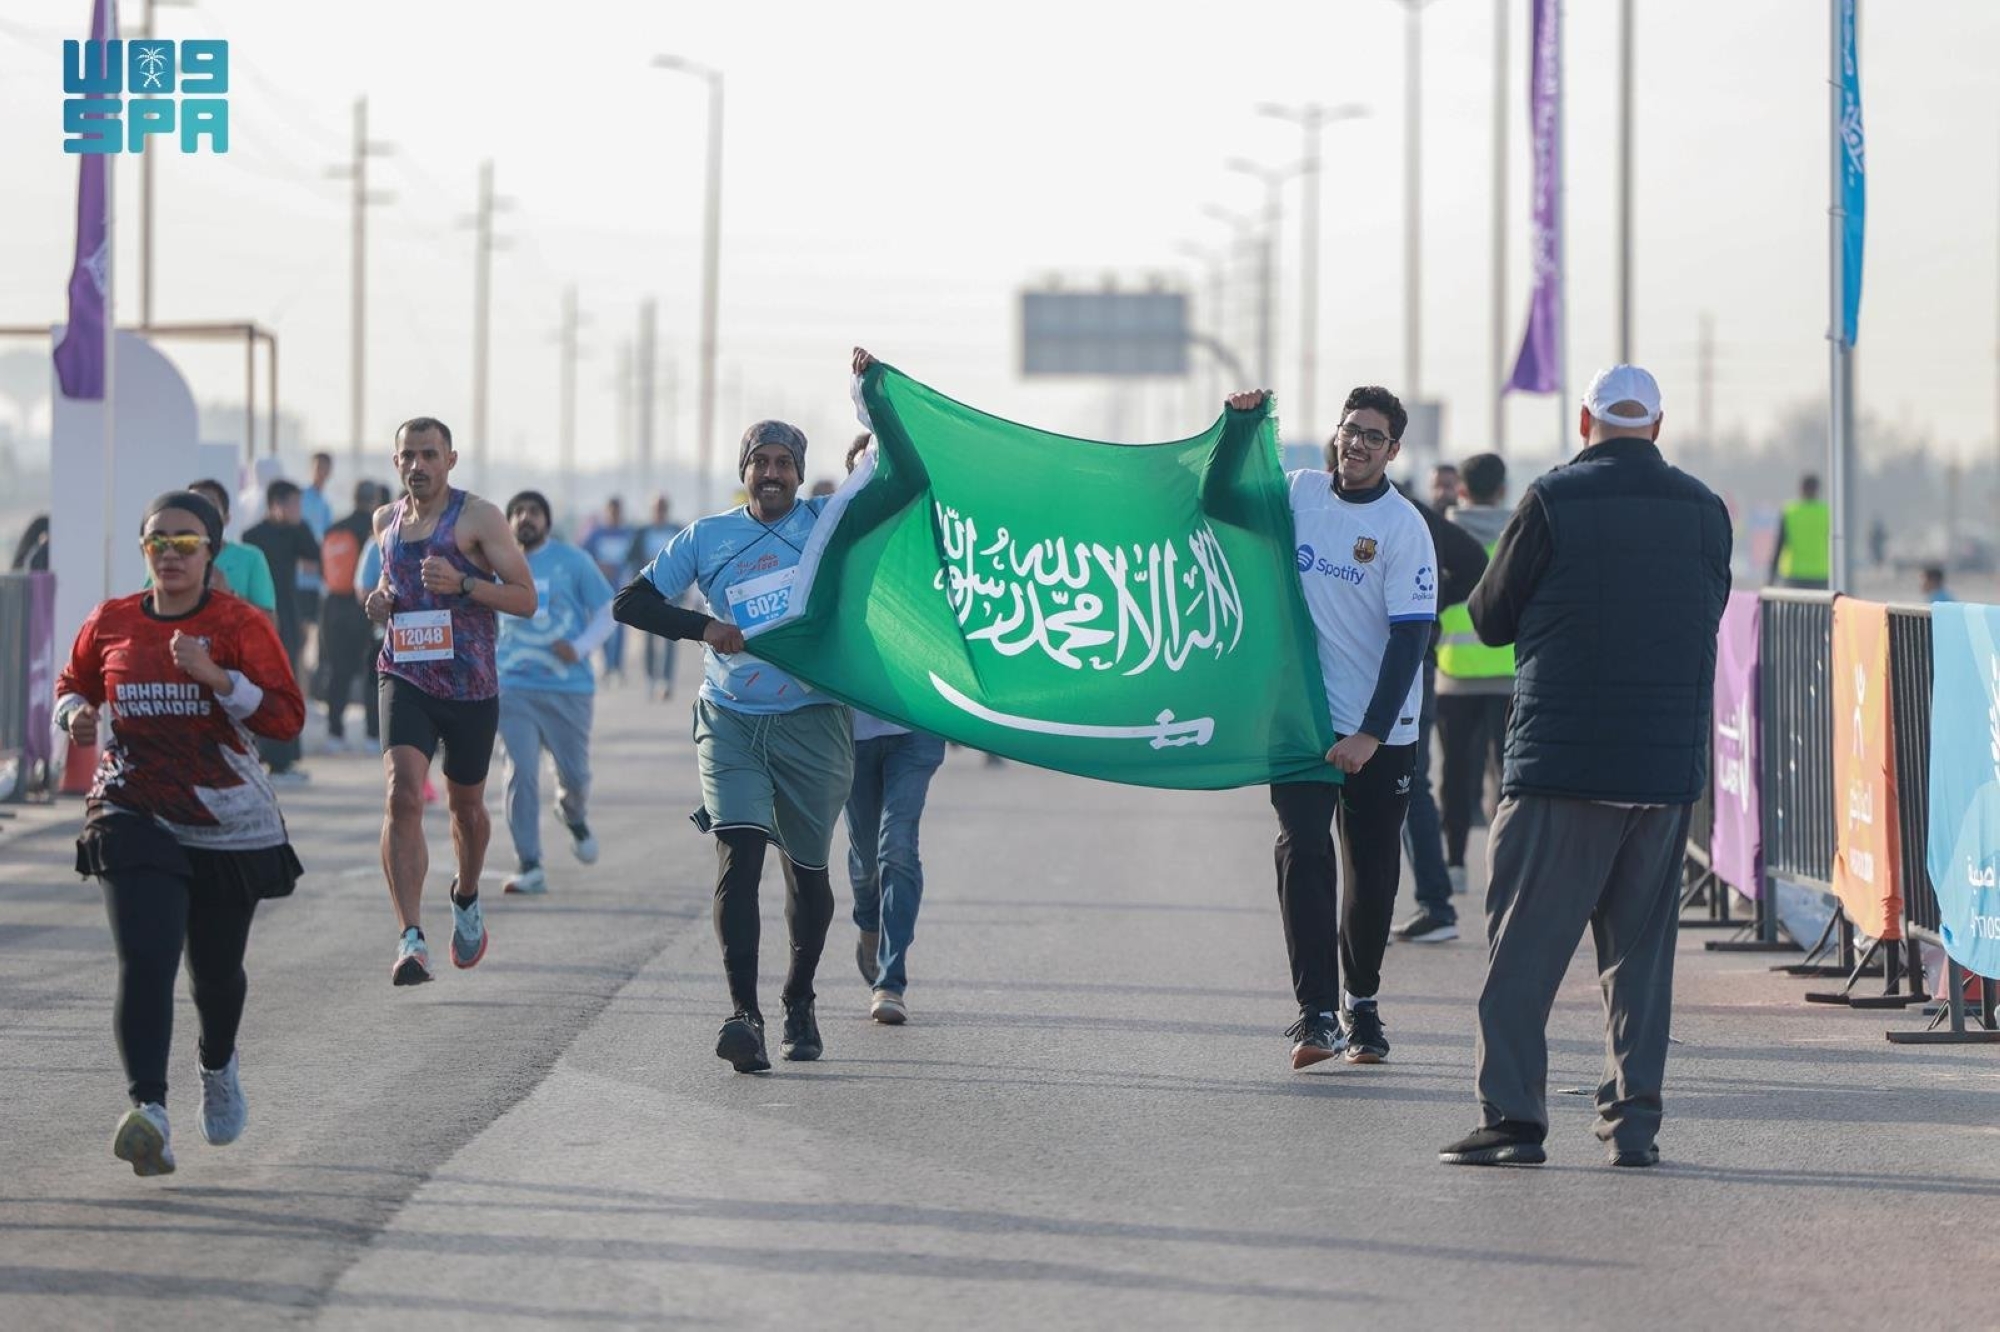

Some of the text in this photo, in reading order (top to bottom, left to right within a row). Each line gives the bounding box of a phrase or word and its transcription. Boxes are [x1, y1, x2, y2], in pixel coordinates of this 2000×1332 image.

[1316, 558, 1366, 585] Spotify
[746, 589, 789, 618] 6023
[400, 627, 444, 646] 12048
[115, 683, 200, 700] BAHRAIN
[113, 700, 211, 717] WARRIORS
